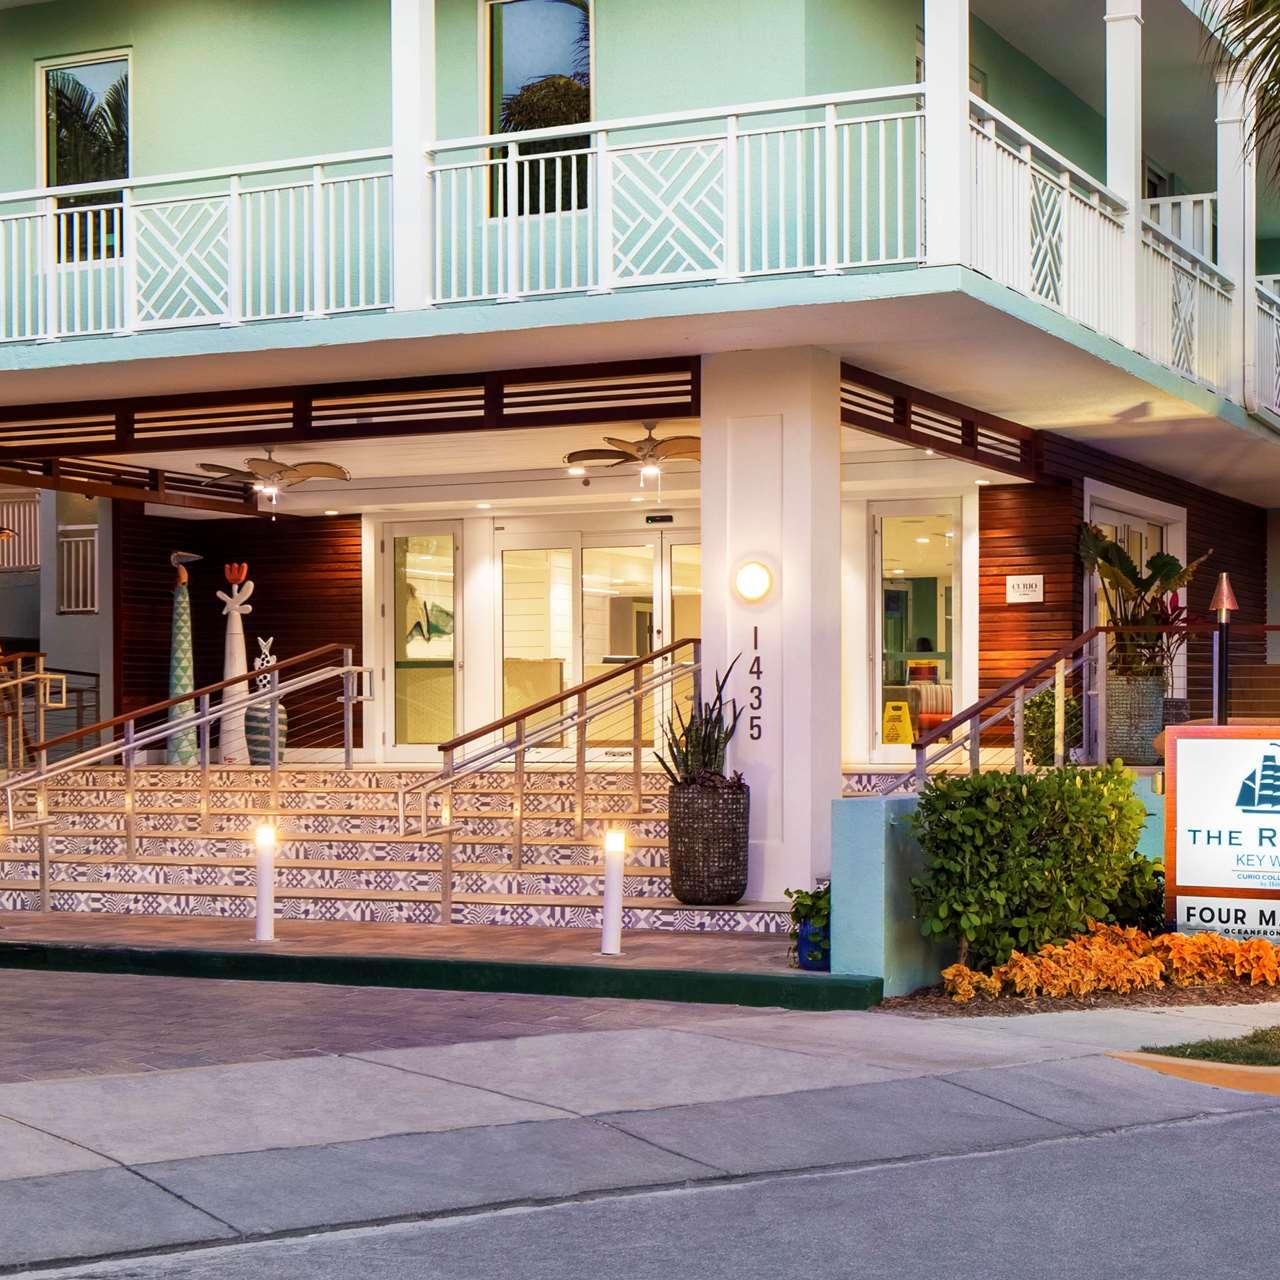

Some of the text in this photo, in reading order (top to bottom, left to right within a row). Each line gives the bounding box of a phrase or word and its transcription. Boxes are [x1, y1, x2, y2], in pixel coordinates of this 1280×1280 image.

[749, 626, 763, 740] 1435
[1187, 829, 1243, 846] THE
[1236, 854, 1267, 867] KEY
[1186, 906, 1247, 925] FOUR
